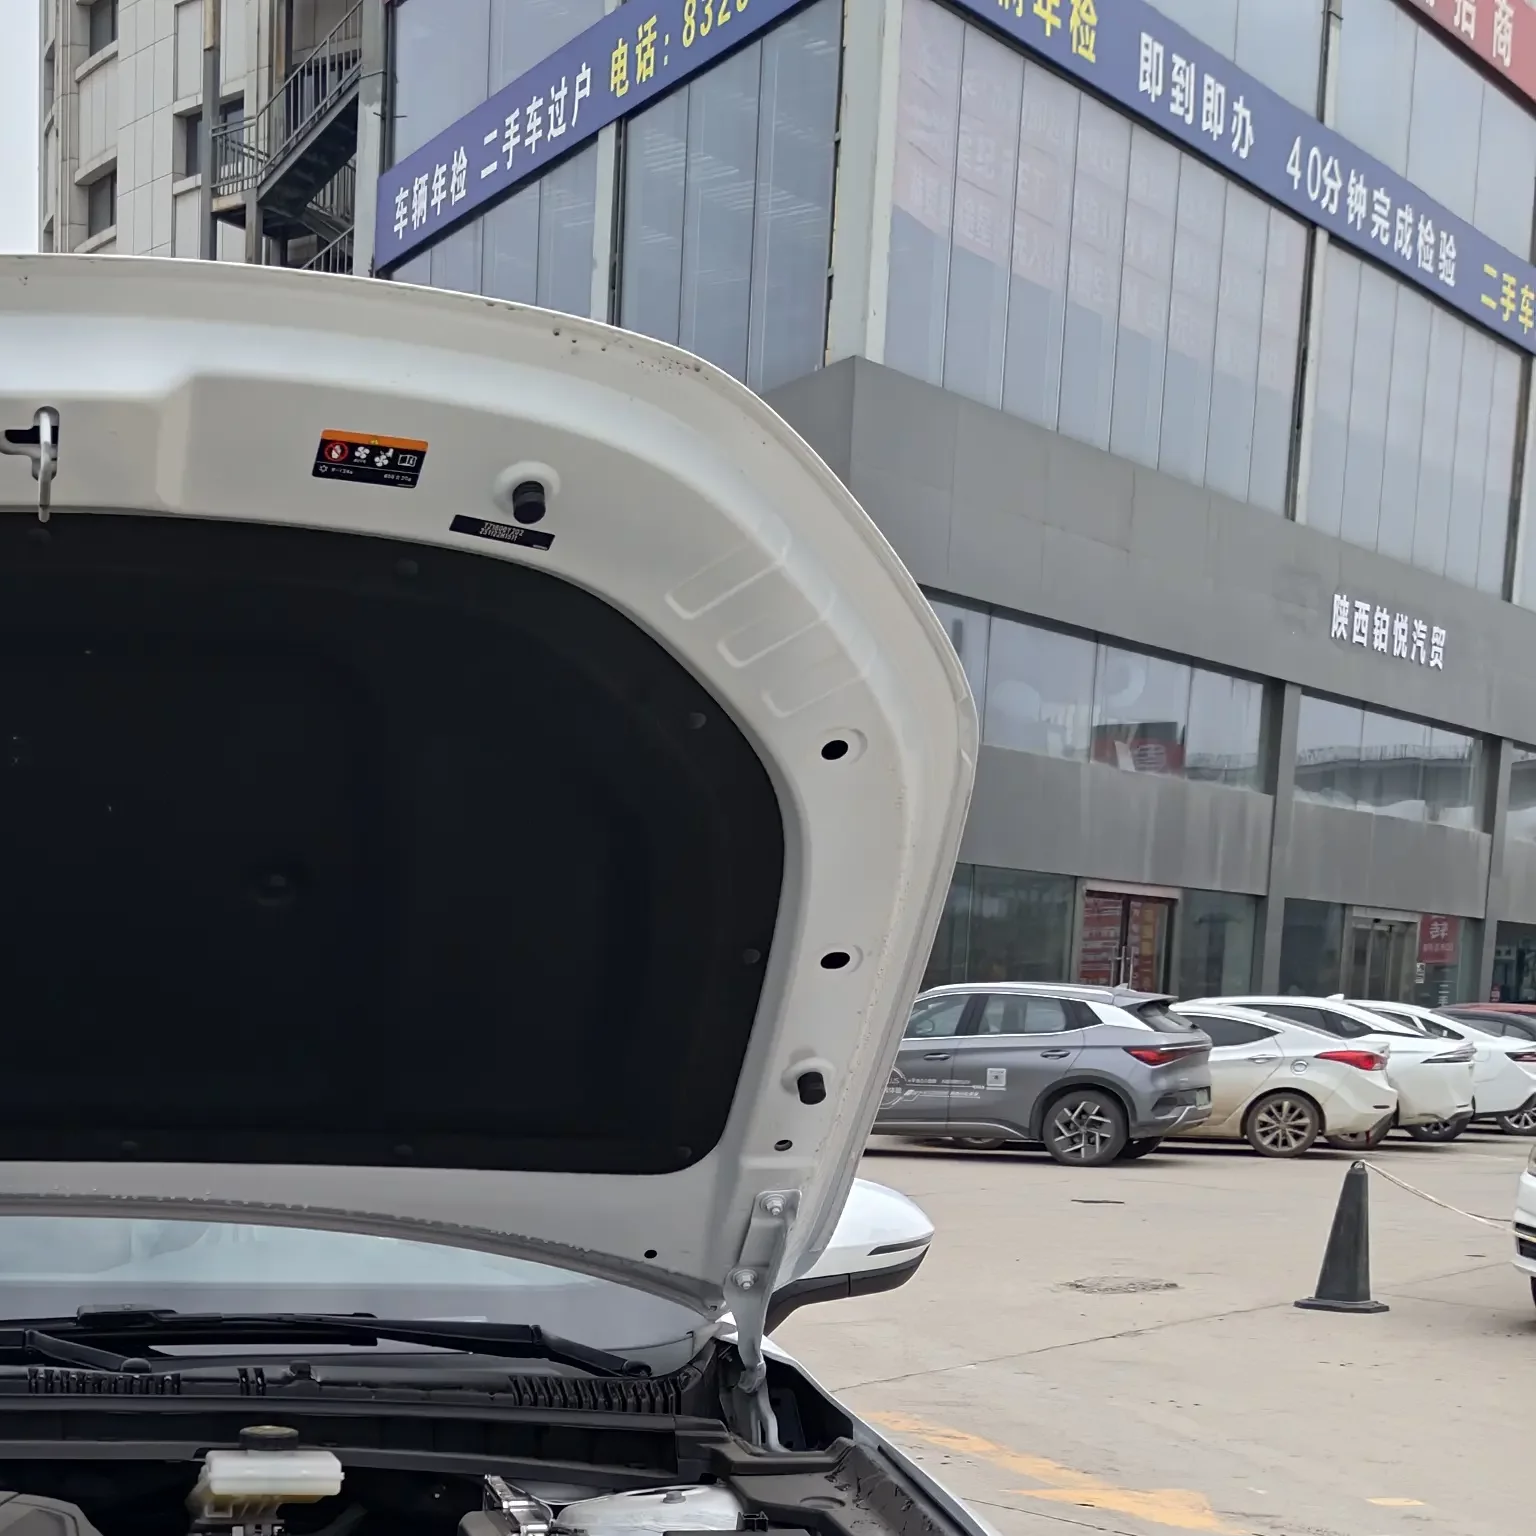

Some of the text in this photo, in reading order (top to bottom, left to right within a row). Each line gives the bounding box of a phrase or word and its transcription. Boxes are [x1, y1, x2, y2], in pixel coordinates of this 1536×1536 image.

[1425, 0, 1515, 68] 招商
[393, 146, 468, 239] 车辆年检
[480, 62, 592, 180] 二手车过户
[998, 0, 1535, 335] 年检 即到即办 40分钟完成检验 二手车
[1331, 593, 1446, 670] 陕西铂悦汽贸
